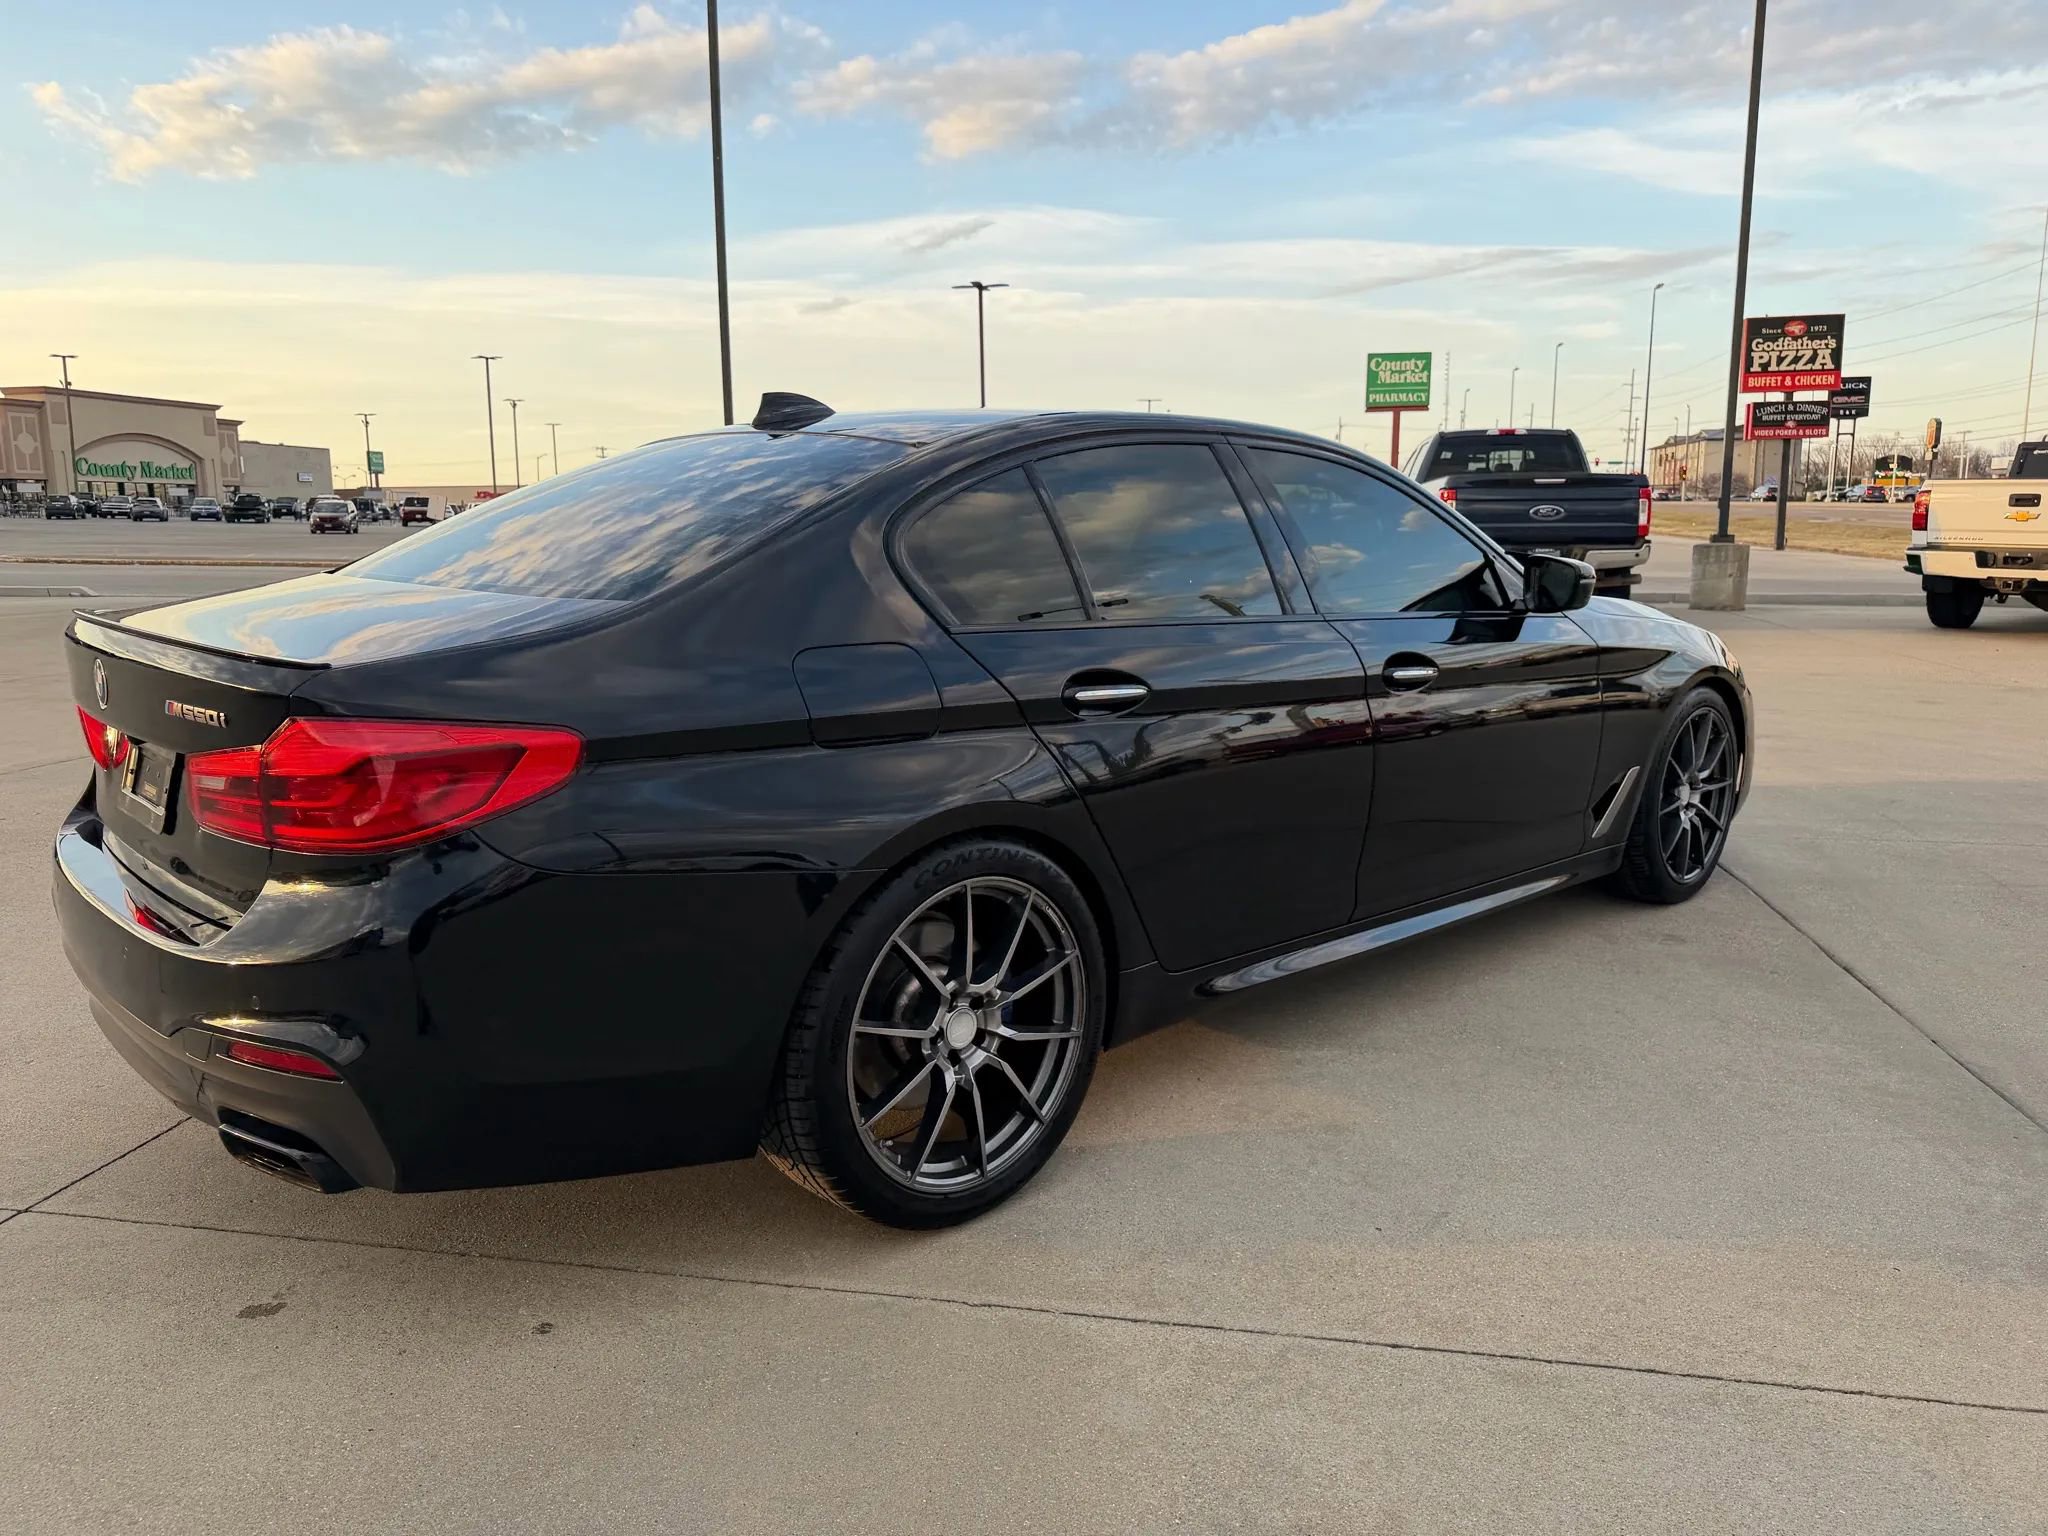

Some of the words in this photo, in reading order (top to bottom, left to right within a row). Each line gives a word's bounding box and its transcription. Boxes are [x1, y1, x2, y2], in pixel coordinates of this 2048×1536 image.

[1751, 335, 1837, 351] Godfather's
[1370, 358, 1426, 372] County
[1750, 349, 1835, 372] PIZZA
[1377, 370, 1429, 384] Market
[1748, 376, 1781, 387] BUFFET
[1784, 376, 1793, 386] &
[1795, 374, 1835, 386] CHICKEN
[1369, 392, 1428, 402] PHARMACY
[1756, 403, 1786, 417] LUNCH
[1787, 403, 1795, 412] &
[1796, 403, 1829, 416] DINNER
[1775, 428, 1797, 436] POKER
[1805, 427, 1827, 435] SLOTS
[76, 457, 137, 481] County
[139, 461, 194, 480] Market
[165, 699, 227, 728] M550i
